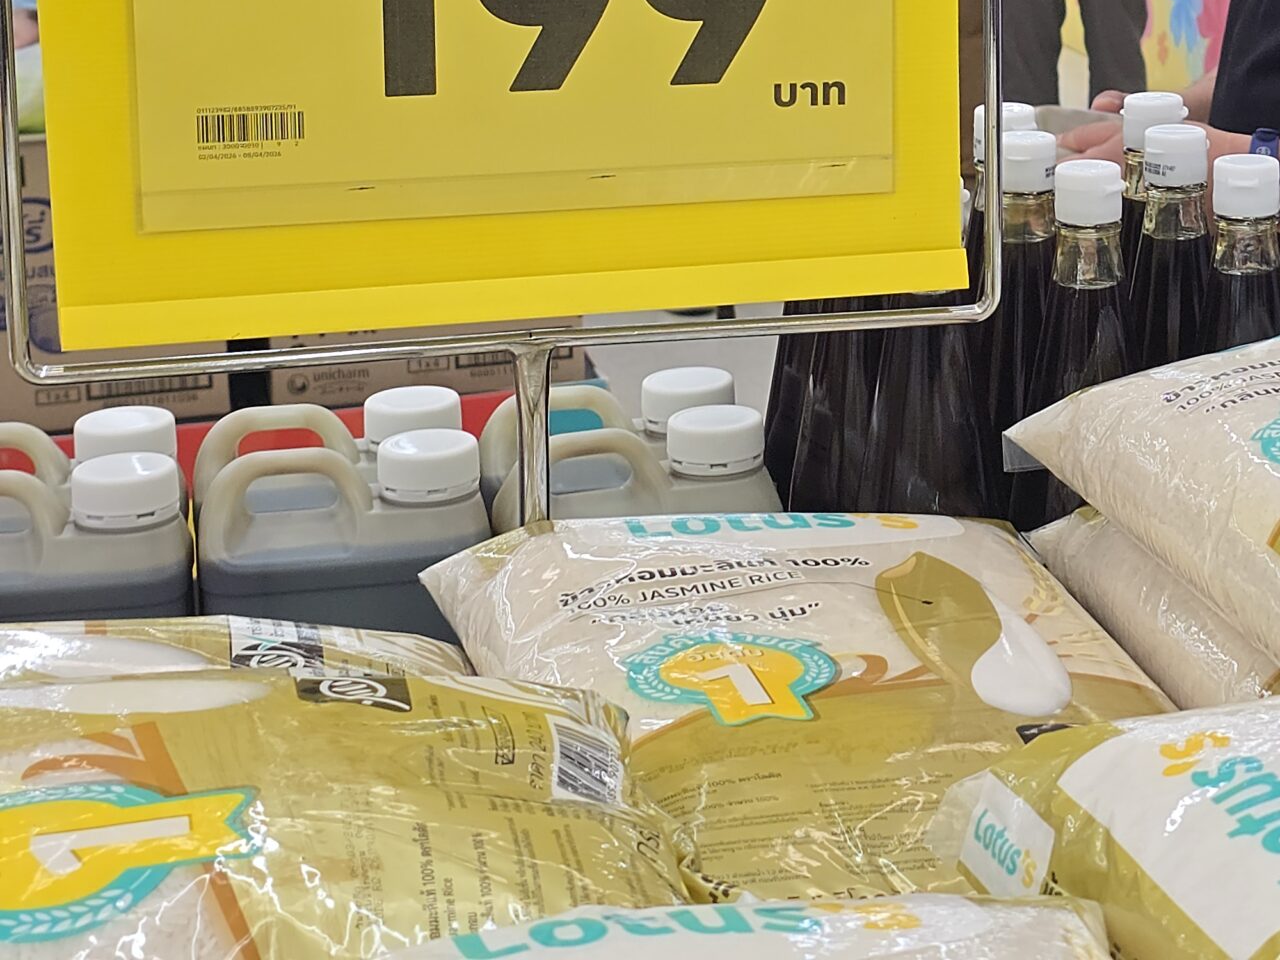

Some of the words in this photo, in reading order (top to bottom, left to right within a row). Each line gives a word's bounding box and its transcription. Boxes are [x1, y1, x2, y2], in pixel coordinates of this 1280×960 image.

[773, 80, 847, 108] บาท
[313, 365, 370, 383] unicharm
[638, 575, 743, 603] JASMINE
[749, 569, 803, 587] RICE
[699, 662, 775, 706] 1
[442, 877, 454, 897] Rice
